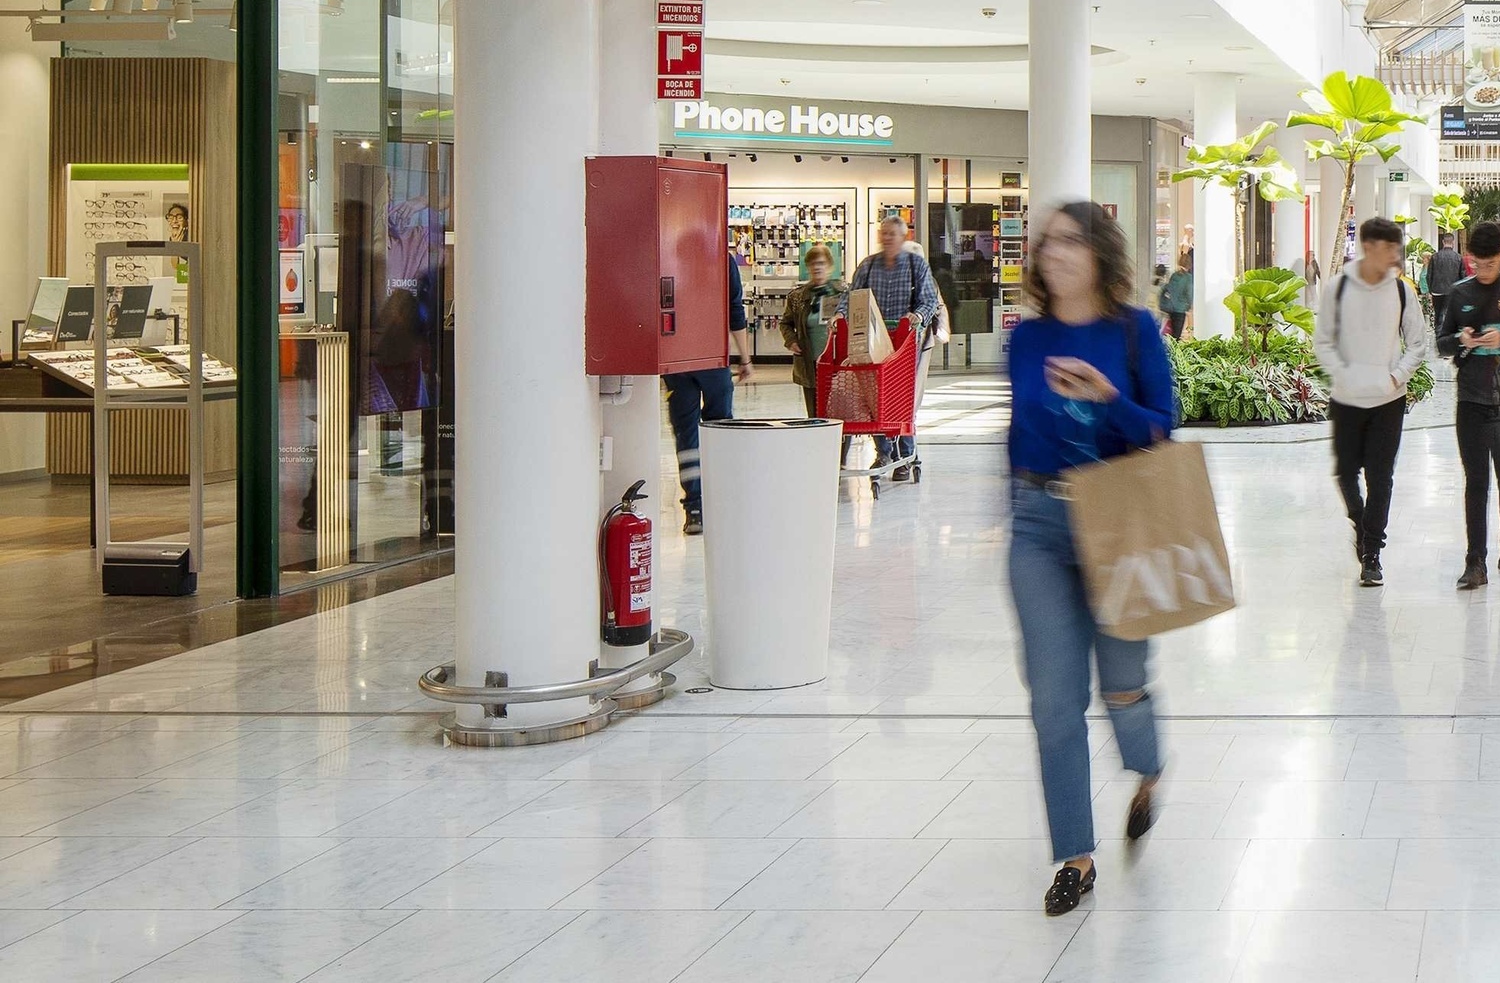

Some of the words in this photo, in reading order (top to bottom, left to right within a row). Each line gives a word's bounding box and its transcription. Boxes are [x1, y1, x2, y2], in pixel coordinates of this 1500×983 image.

[660, 5, 691, 14] EXTINTOR
[692, 6, 702, 14] DE
[662, 14, 698, 22] INCENDIOS
[665, 80, 684, 89] BOCA
[684, 81, 694, 89] DE
[663, 89, 695, 98] INCENDIO
[674, 101, 785, 133] Phone
[790, 105, 894, 138] House
